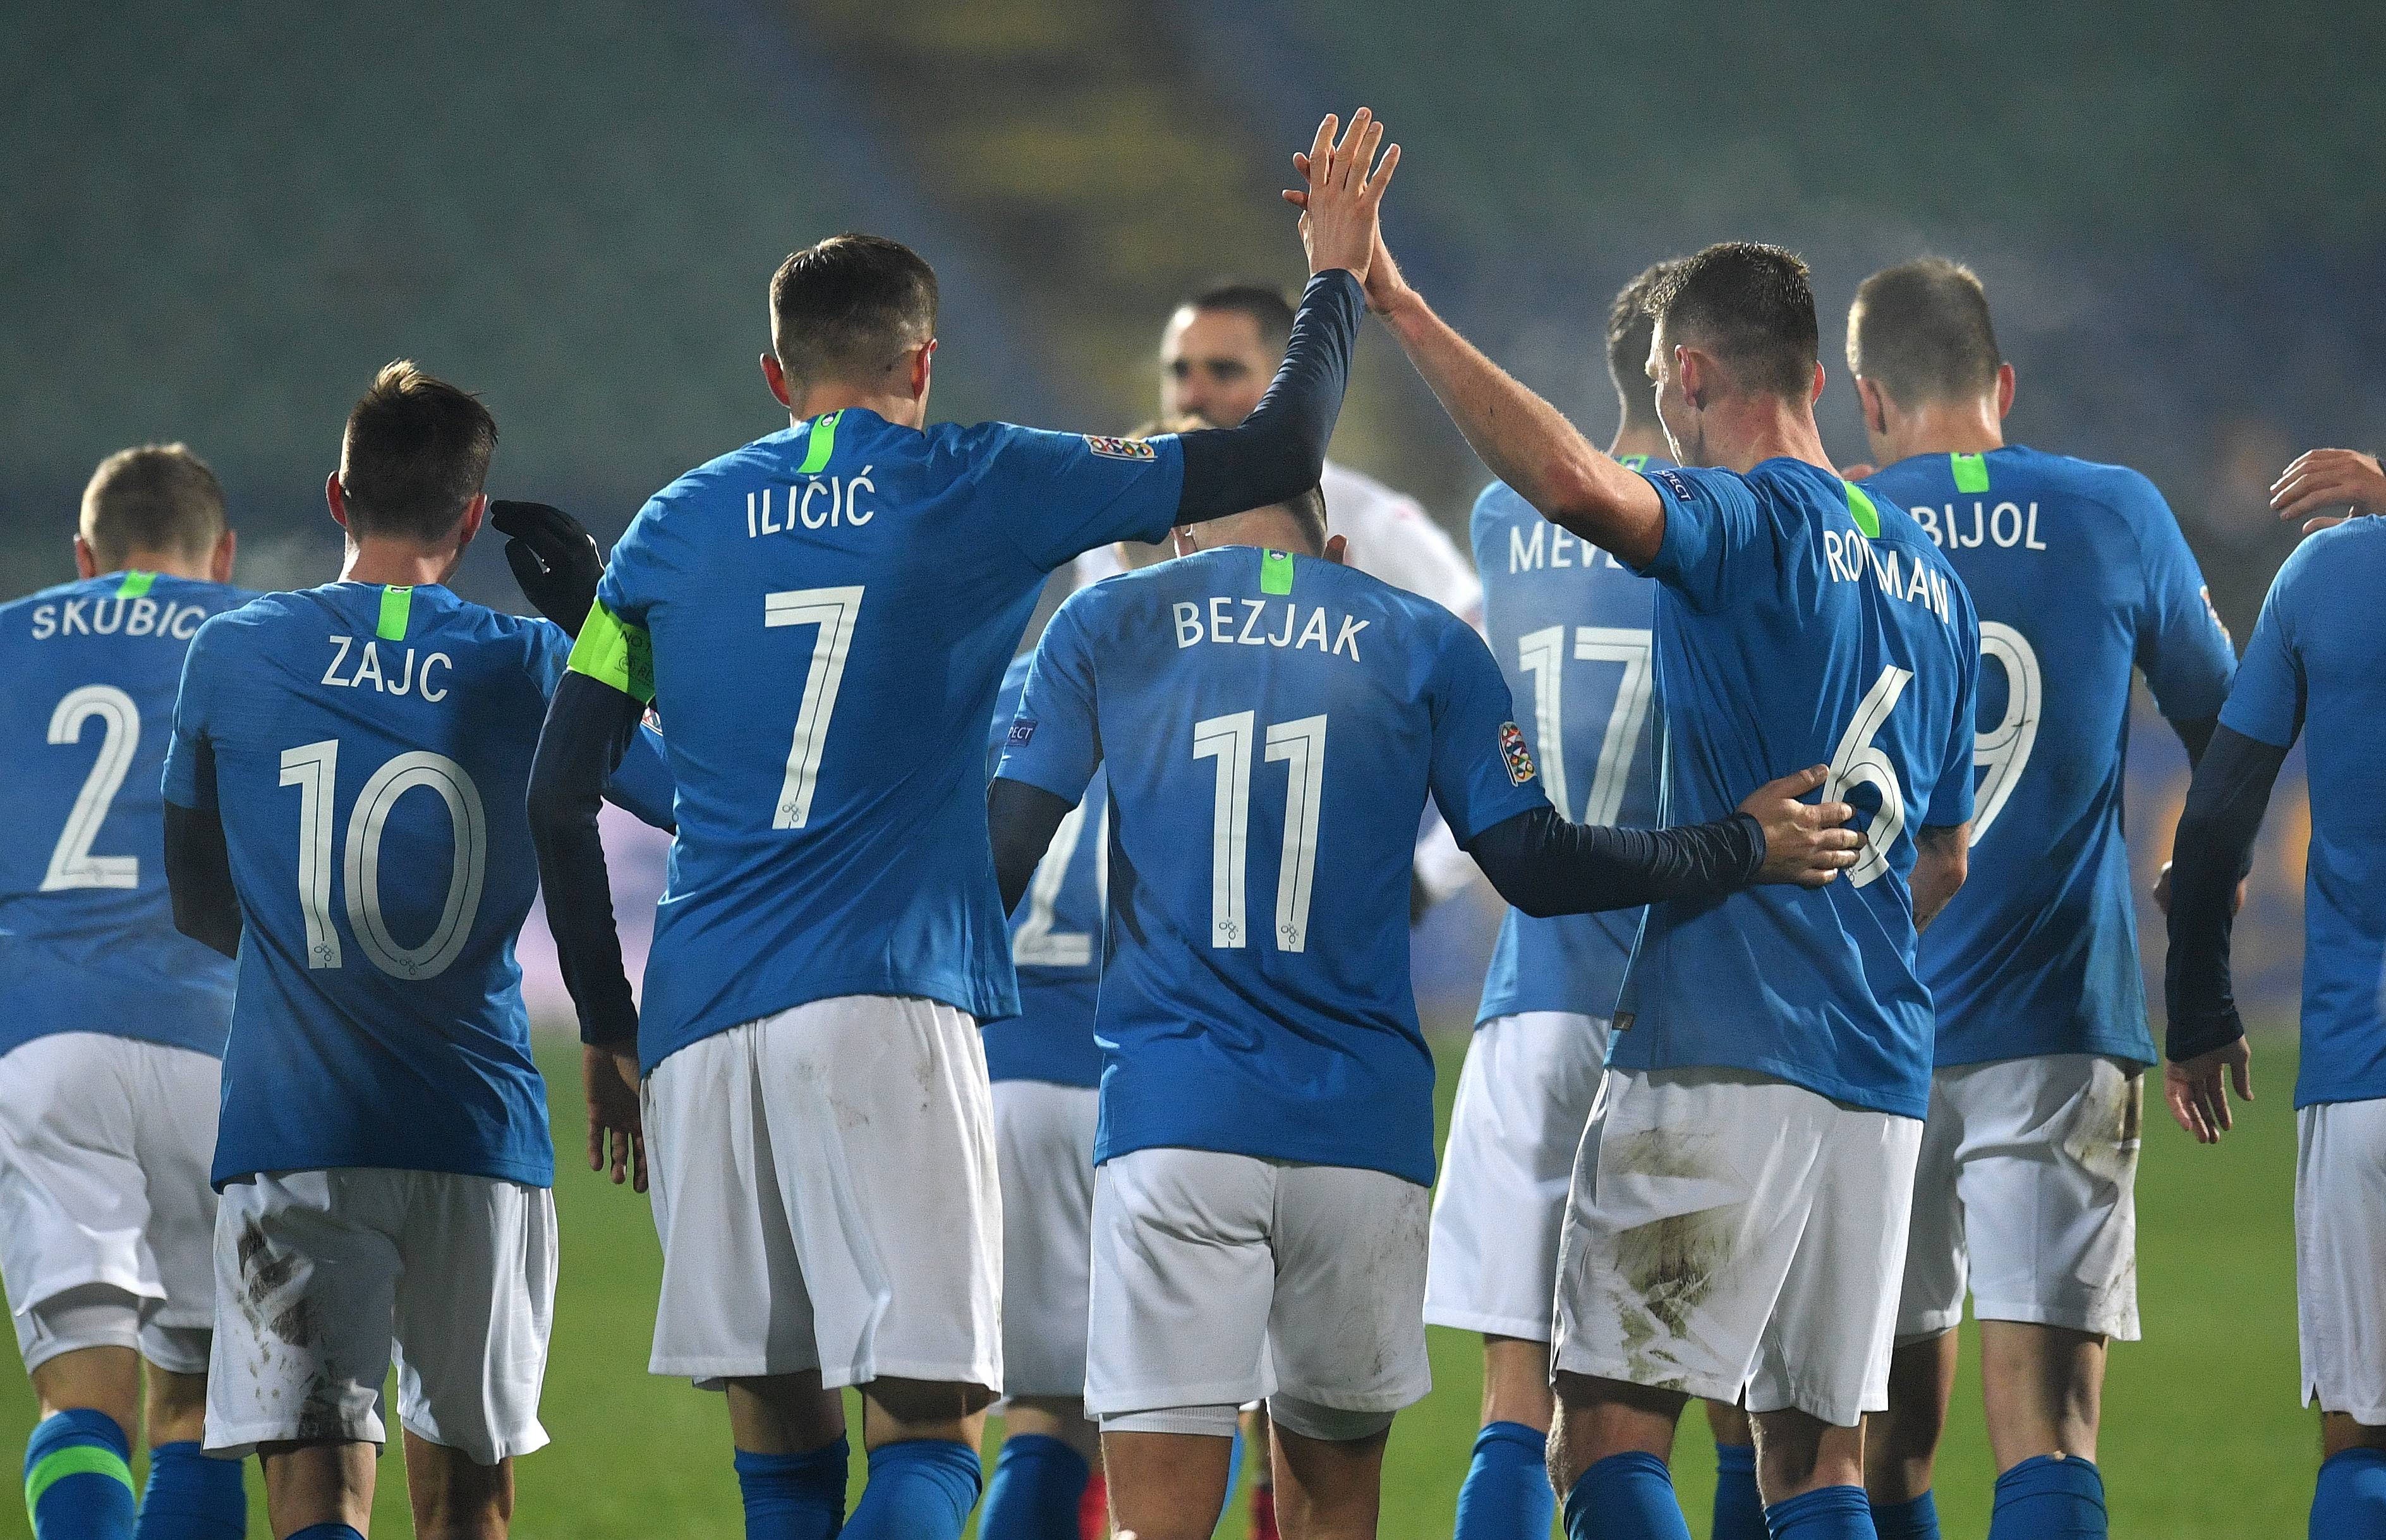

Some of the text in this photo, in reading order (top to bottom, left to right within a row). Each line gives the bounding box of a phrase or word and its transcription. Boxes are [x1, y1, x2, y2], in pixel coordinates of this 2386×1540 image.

[747, 465, 875, 538] ILIČIĆ
[1911, 501, 2047, 551] BIJOL
[32, 597, 206, 640] SKUBIC
[321, 635, 452, 702] ZAJC
[765, 585, 866, 830] 7
[1173, 597, 1371, 662] BEZJAK
[39, 684, 141, 892] 2
[1518, 625, 1652, 826] 17
[1820, 664, 1915, 888] 6
[1968, 621, 2042, 847] 9
[279, 739, 487, 981] 10
[1193, 710, 1328, 953] 11
